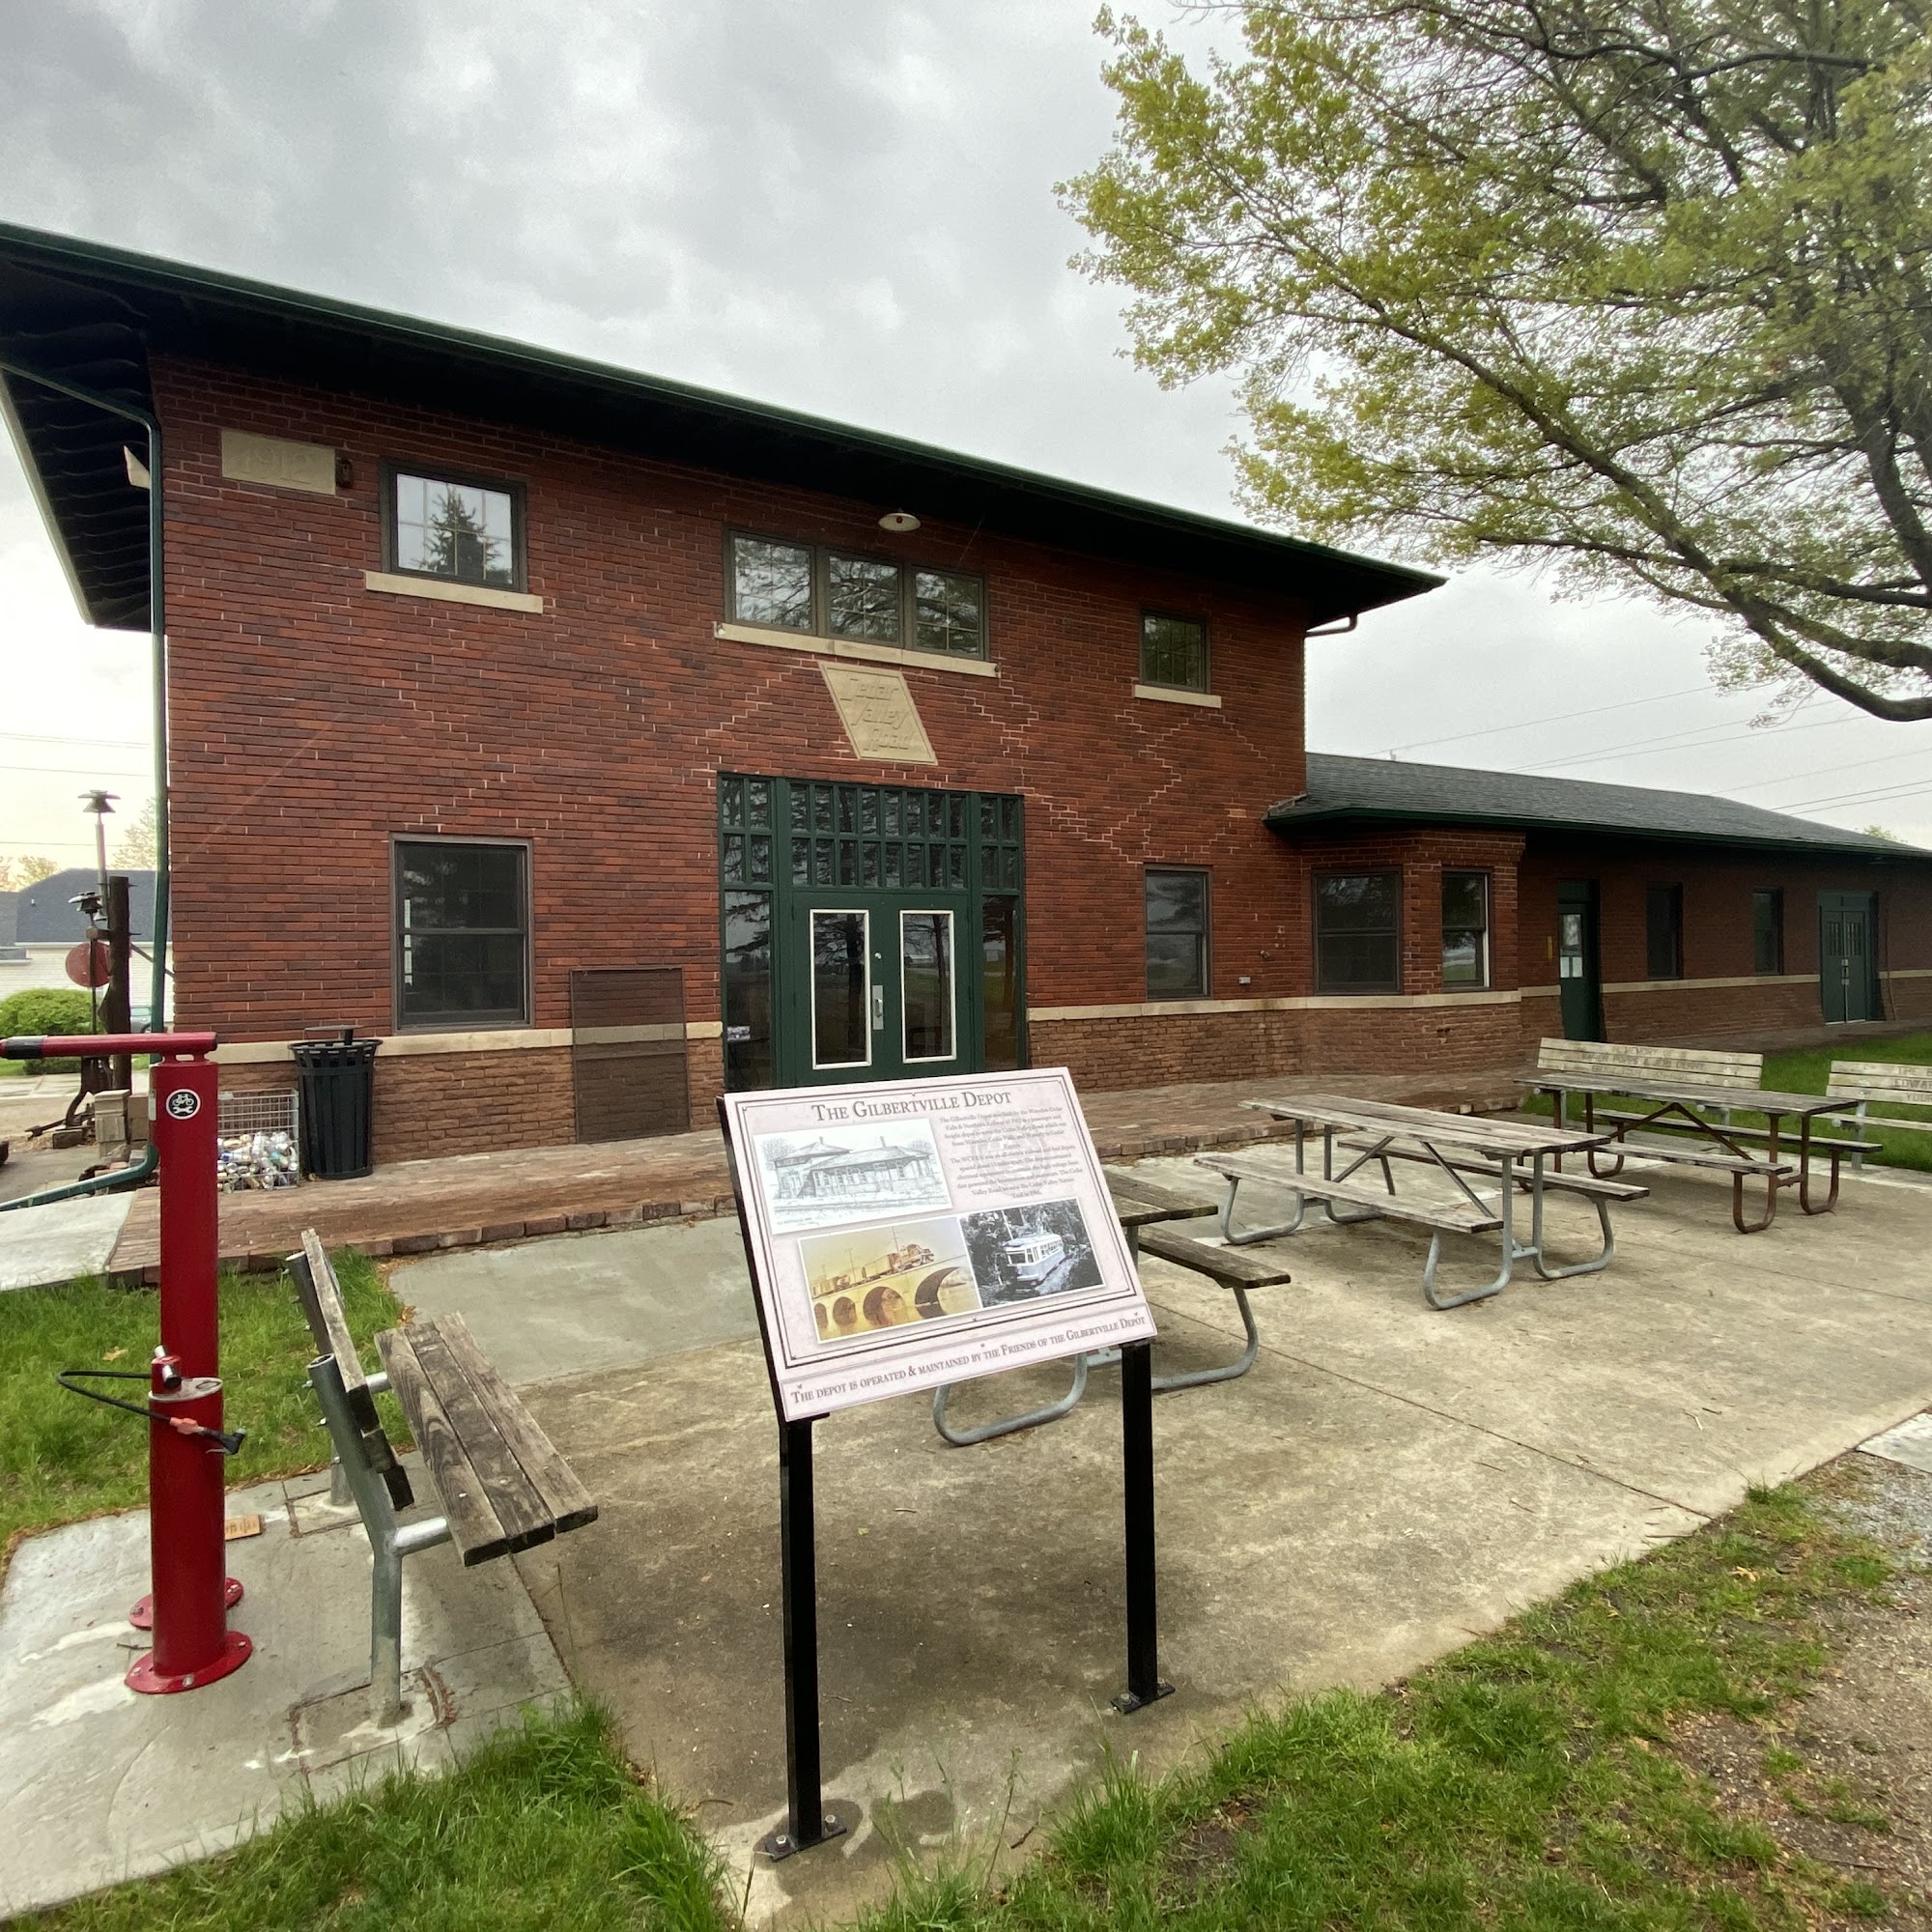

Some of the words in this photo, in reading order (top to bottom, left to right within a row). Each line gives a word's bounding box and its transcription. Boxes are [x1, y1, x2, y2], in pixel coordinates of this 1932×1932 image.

[816, 1383, 847, 1398] DEPOT
[849, 1380, 858, 1390] IS
[860, 1370, 907, 1388] OPERATED
[908, 1365, 918, 1377] &
[919, 1354, 970, 1375] MAINTAINED
[972, 1352, 982, 1363] BY
[983, 1350, 1001, 1360] THE
[1037, 1339, 1048, 1348] OF
[1049, 1335, 1066, 1346] THE
